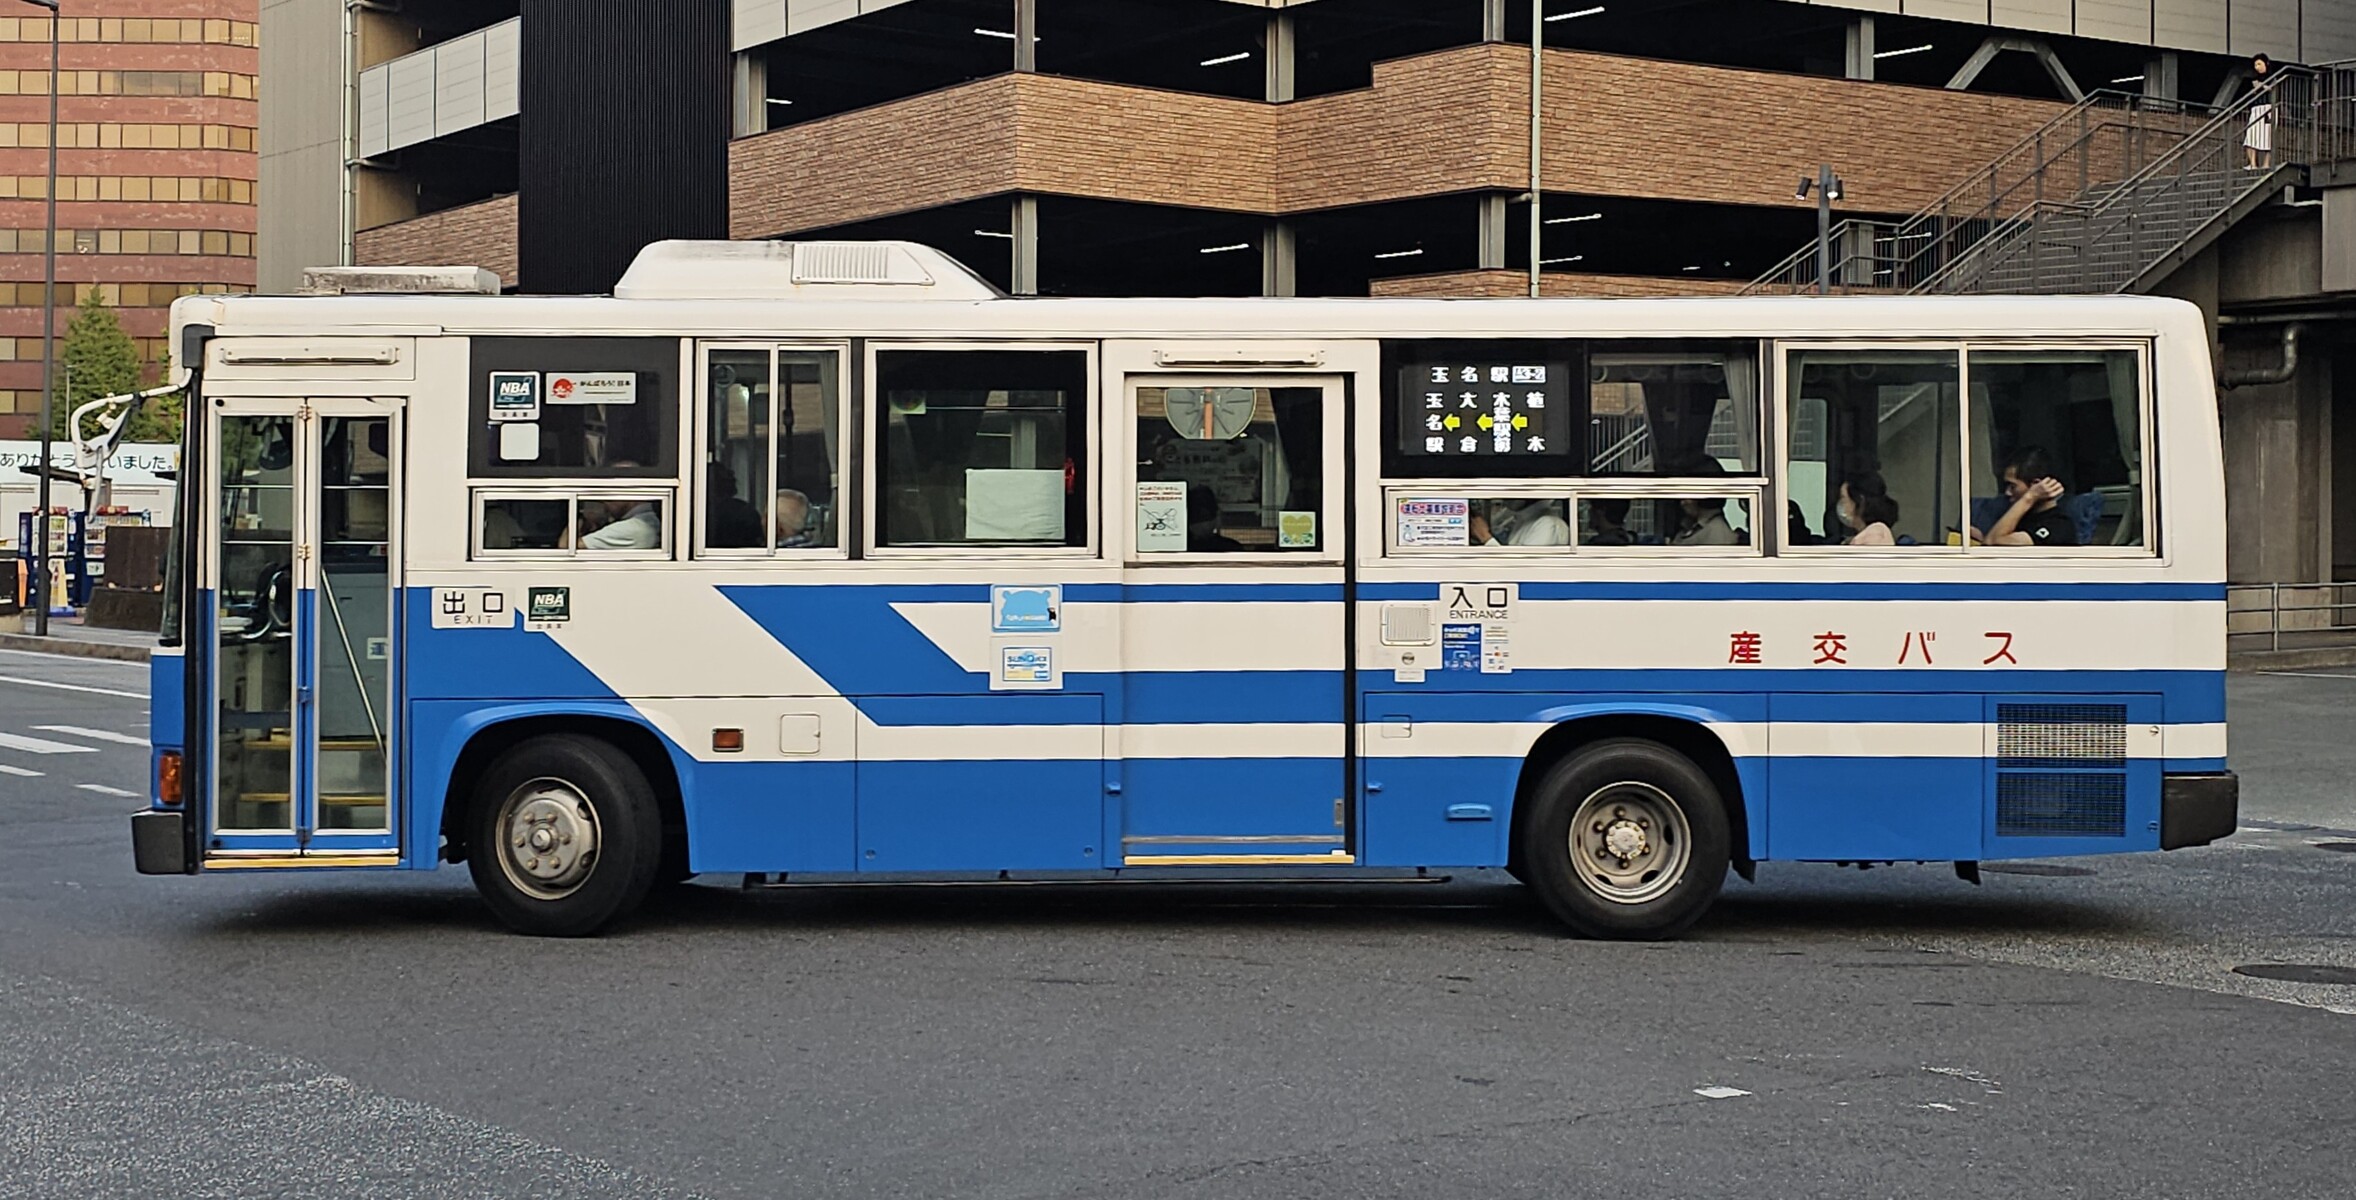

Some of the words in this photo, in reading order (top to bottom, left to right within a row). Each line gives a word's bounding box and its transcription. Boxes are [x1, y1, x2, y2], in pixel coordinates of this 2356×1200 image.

[1431, 366, 1509, 382] 玉名駅
[500, 382, 530, 396] NBA
[1425, 393, 1444, 452] 玉名駅
[443, 591, 503, 614] 出口
[534, 594, 564, 607] NBA
[1450, 587, 1507, 608] 入口
[454, 615, 493, 624] EXIT
[1450, 610, 1508, 619] ENTRANCE
[1728, 631, 2017, 665] 産交バス
